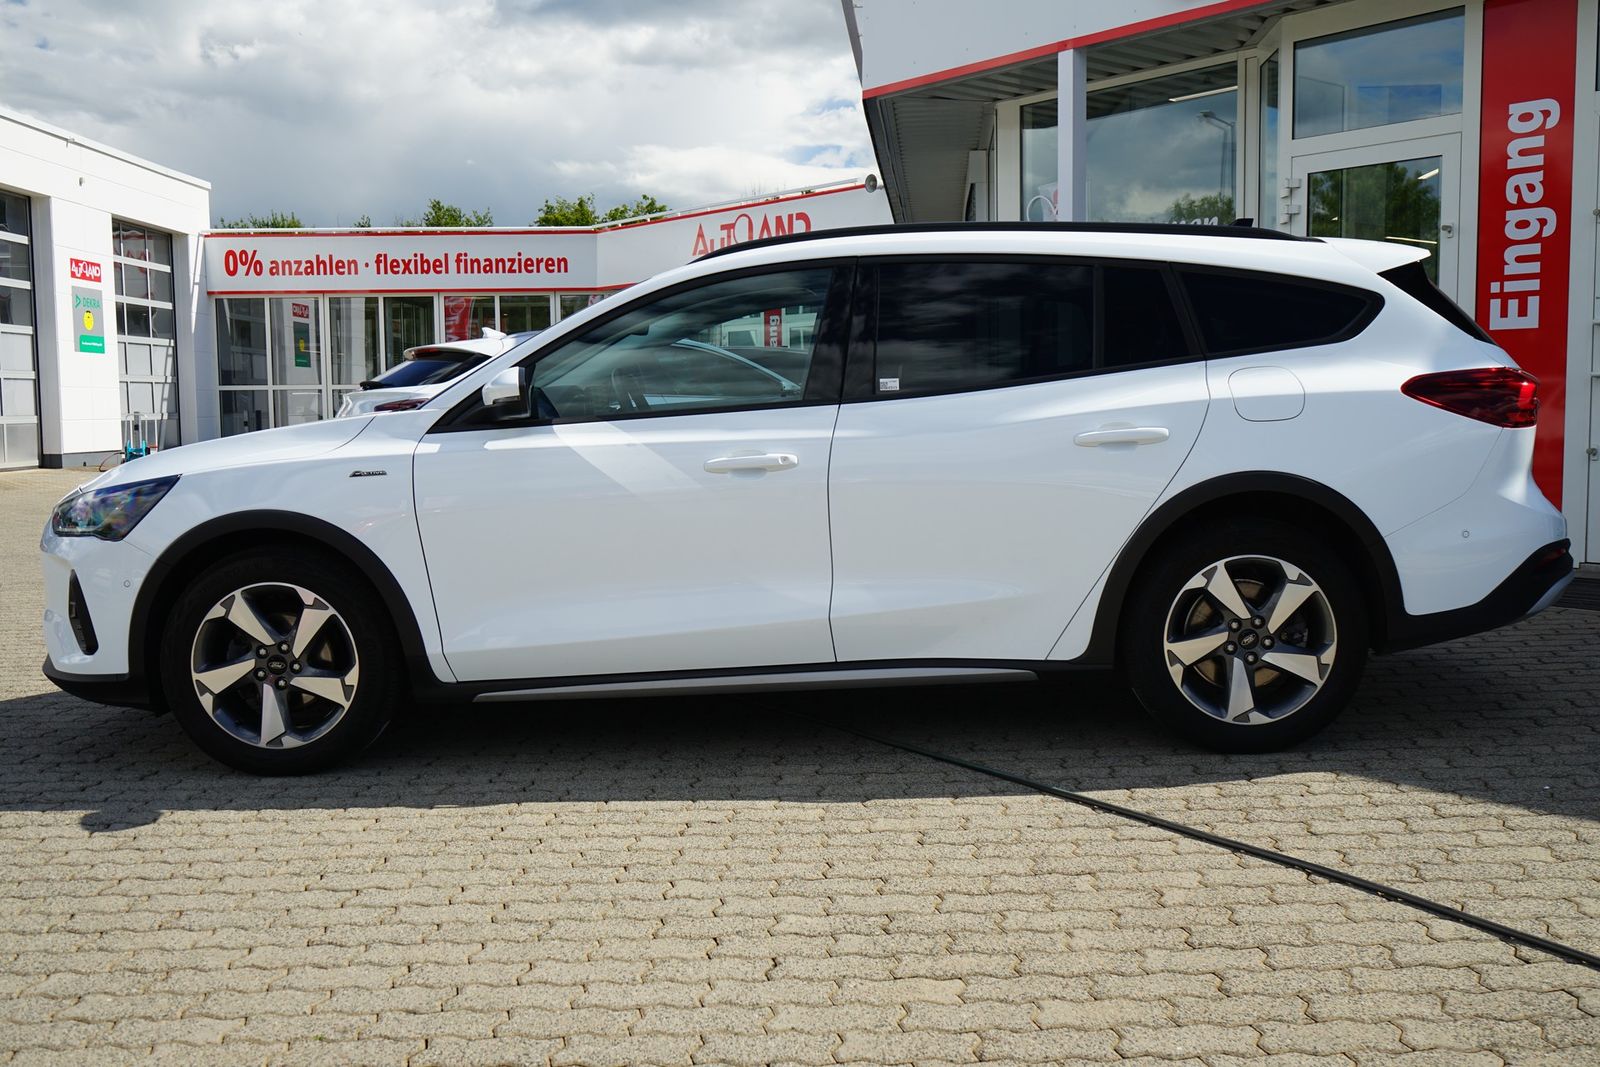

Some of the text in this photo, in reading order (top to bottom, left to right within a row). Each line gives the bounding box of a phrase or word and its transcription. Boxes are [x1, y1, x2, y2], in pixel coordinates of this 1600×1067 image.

[224, 249, 263, 277] 0%
[268, 254, 359, 276] anzahlen
[374, 252, 449, 275] flexibel
[455, 251, 569, 275] finanzieren
[1489, 98, 1561, 331] Eingang
